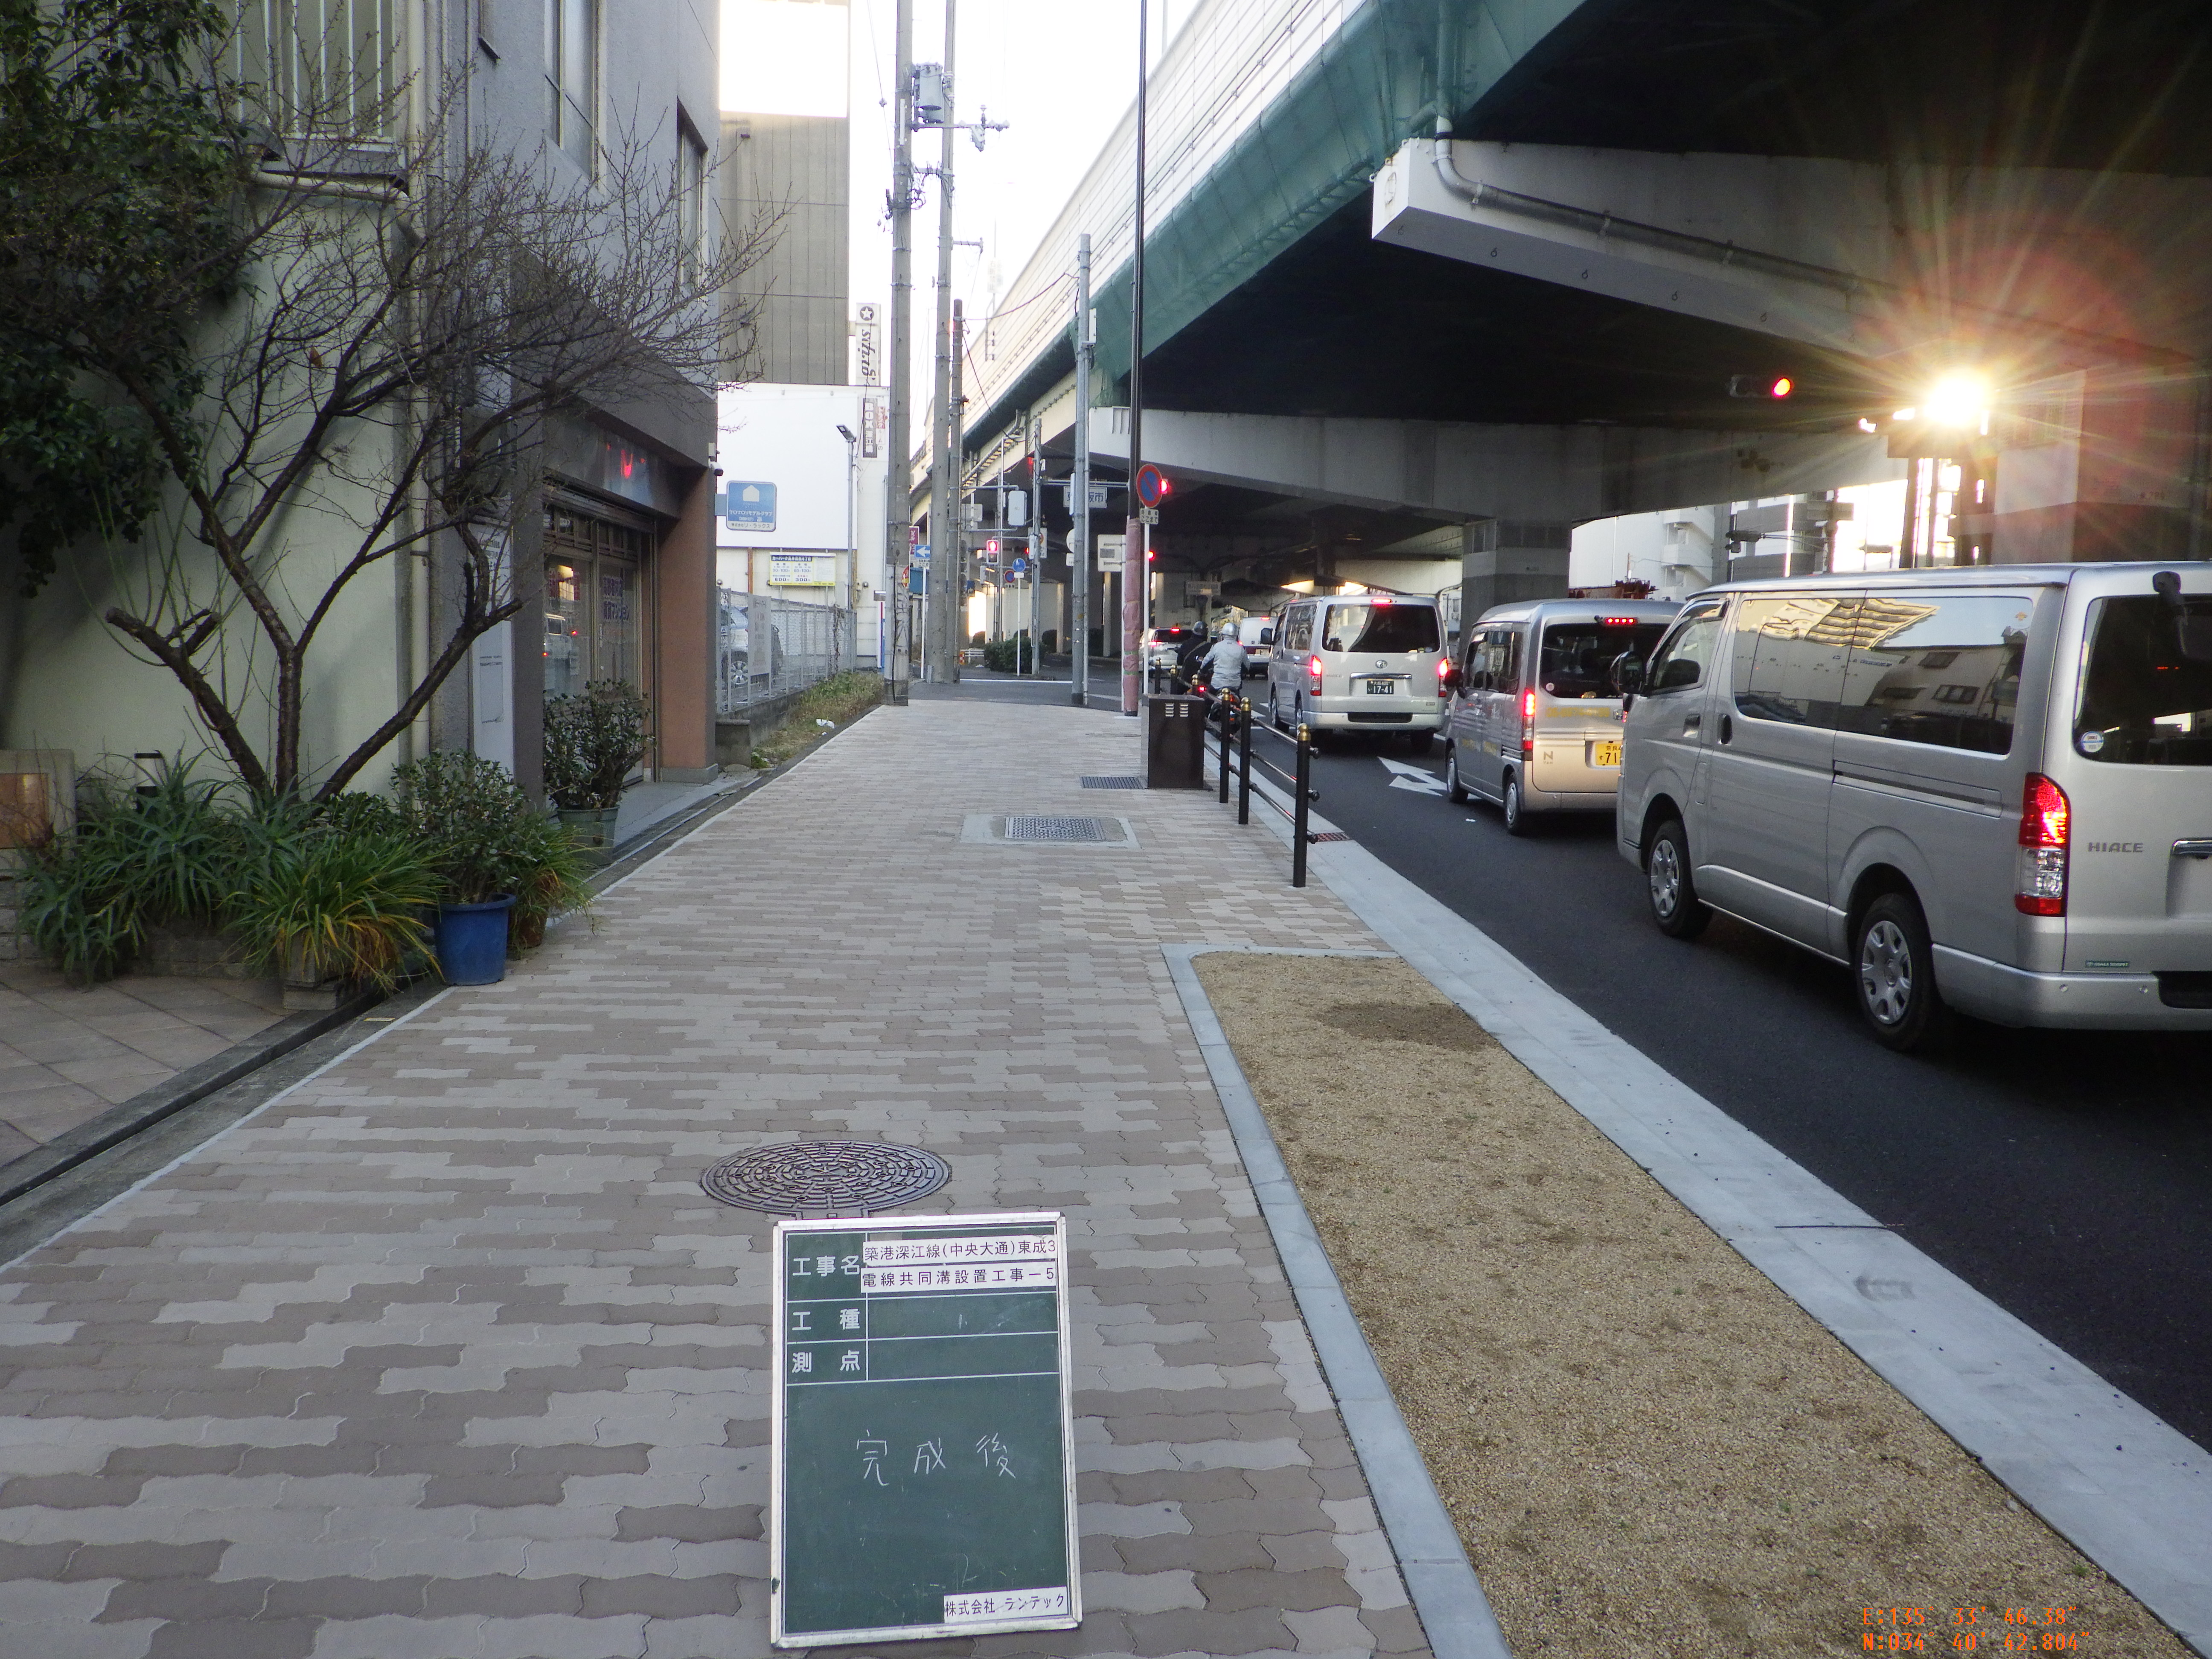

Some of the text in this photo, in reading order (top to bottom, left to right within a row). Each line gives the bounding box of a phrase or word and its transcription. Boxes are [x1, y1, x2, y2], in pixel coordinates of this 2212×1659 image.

[2088, 842, 2144, 853] HIACE
[792, 1255, 861, 1277] 工事名
[856, 1429, 1016, 1486] 完成後
[945, 1594, 1064, 1616] 株式会社 ランテック
